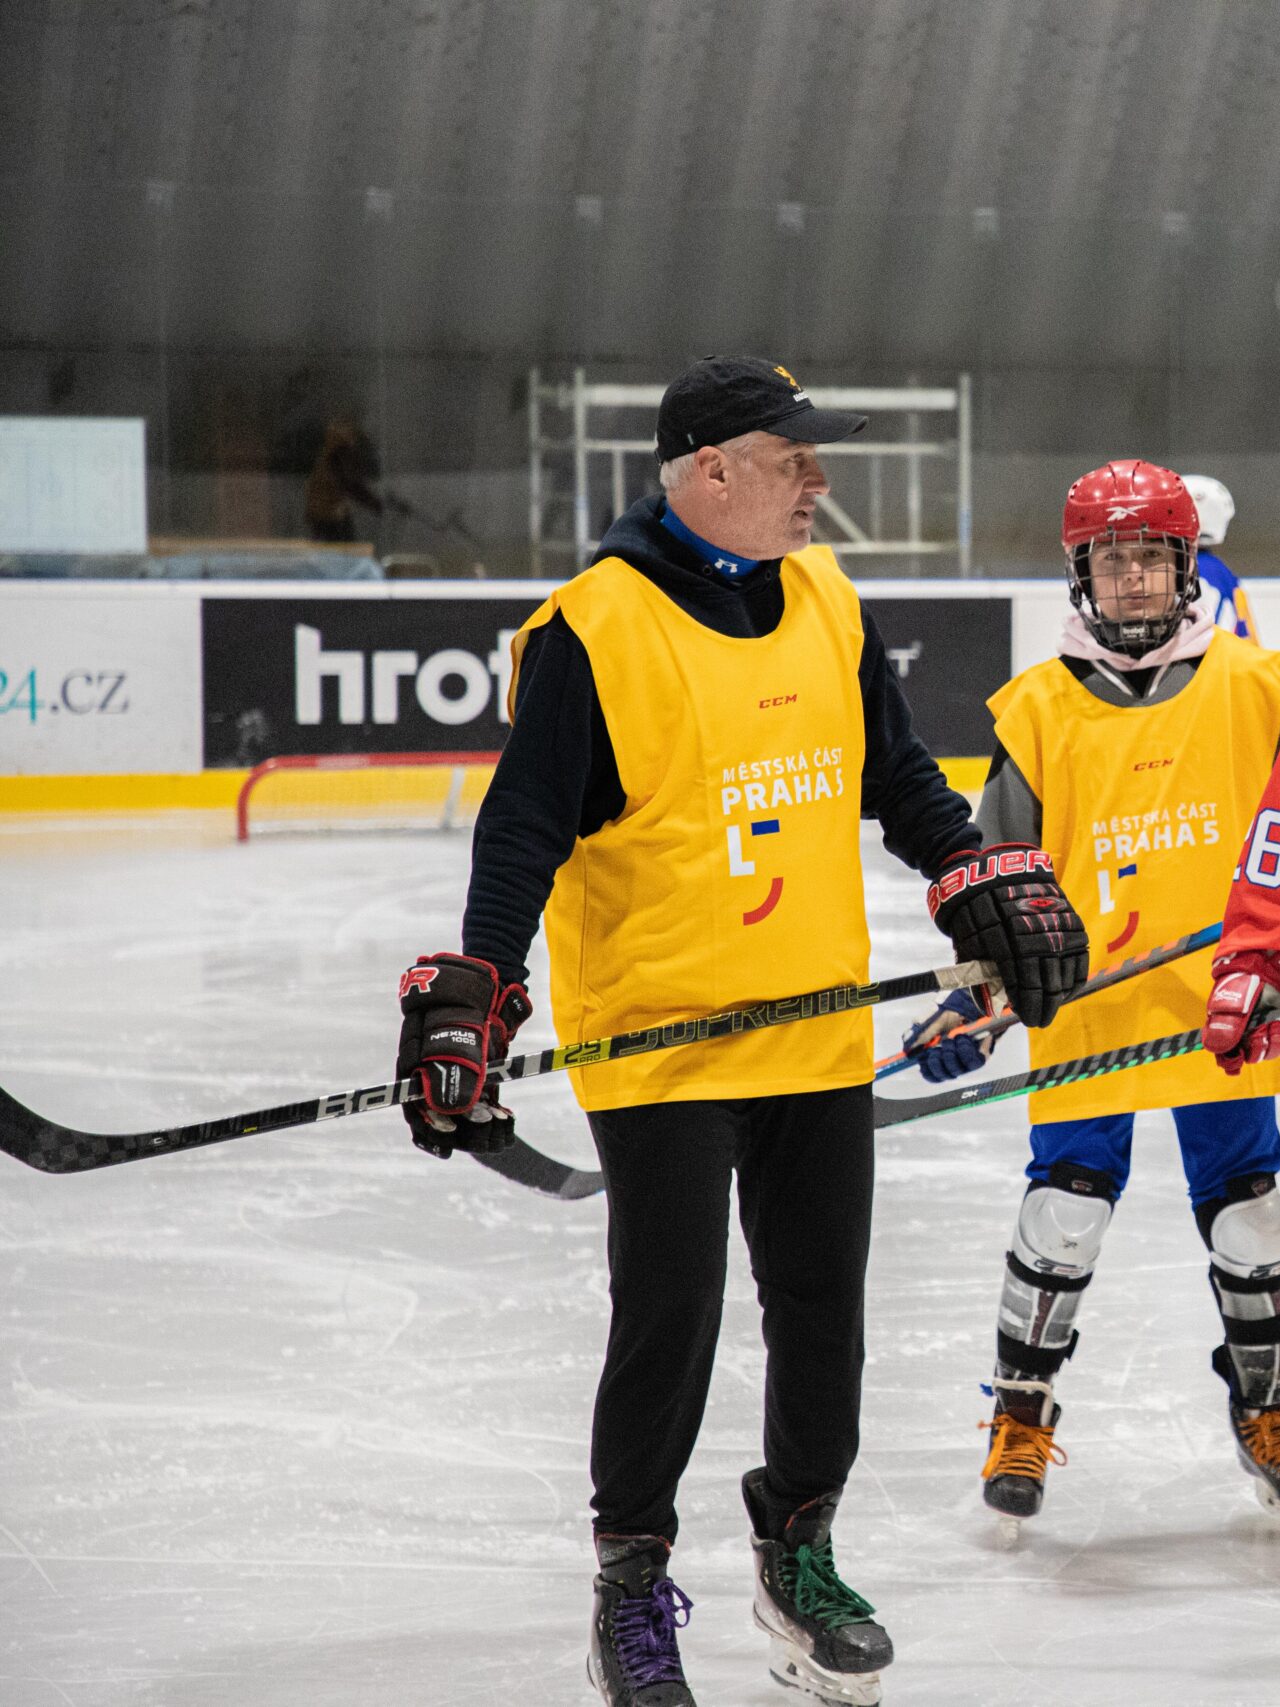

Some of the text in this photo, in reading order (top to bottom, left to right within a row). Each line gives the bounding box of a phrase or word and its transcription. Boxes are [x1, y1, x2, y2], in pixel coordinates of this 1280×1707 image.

[758, 693, 798, 709] CCM
[722, 746, 843, 785] MĚSTSKÁ ČÁST
[1133, 758, 1174, 771] CCM
[720, 767, 844, 816] PRAHA 5
[1094, 820, 1220, 862] PRAHA 5
[430, 1029, 477, 1041] NEXUS
[451, 1035, 477, 1047] 1000
[579, 1053, 601, 1063] PRO
